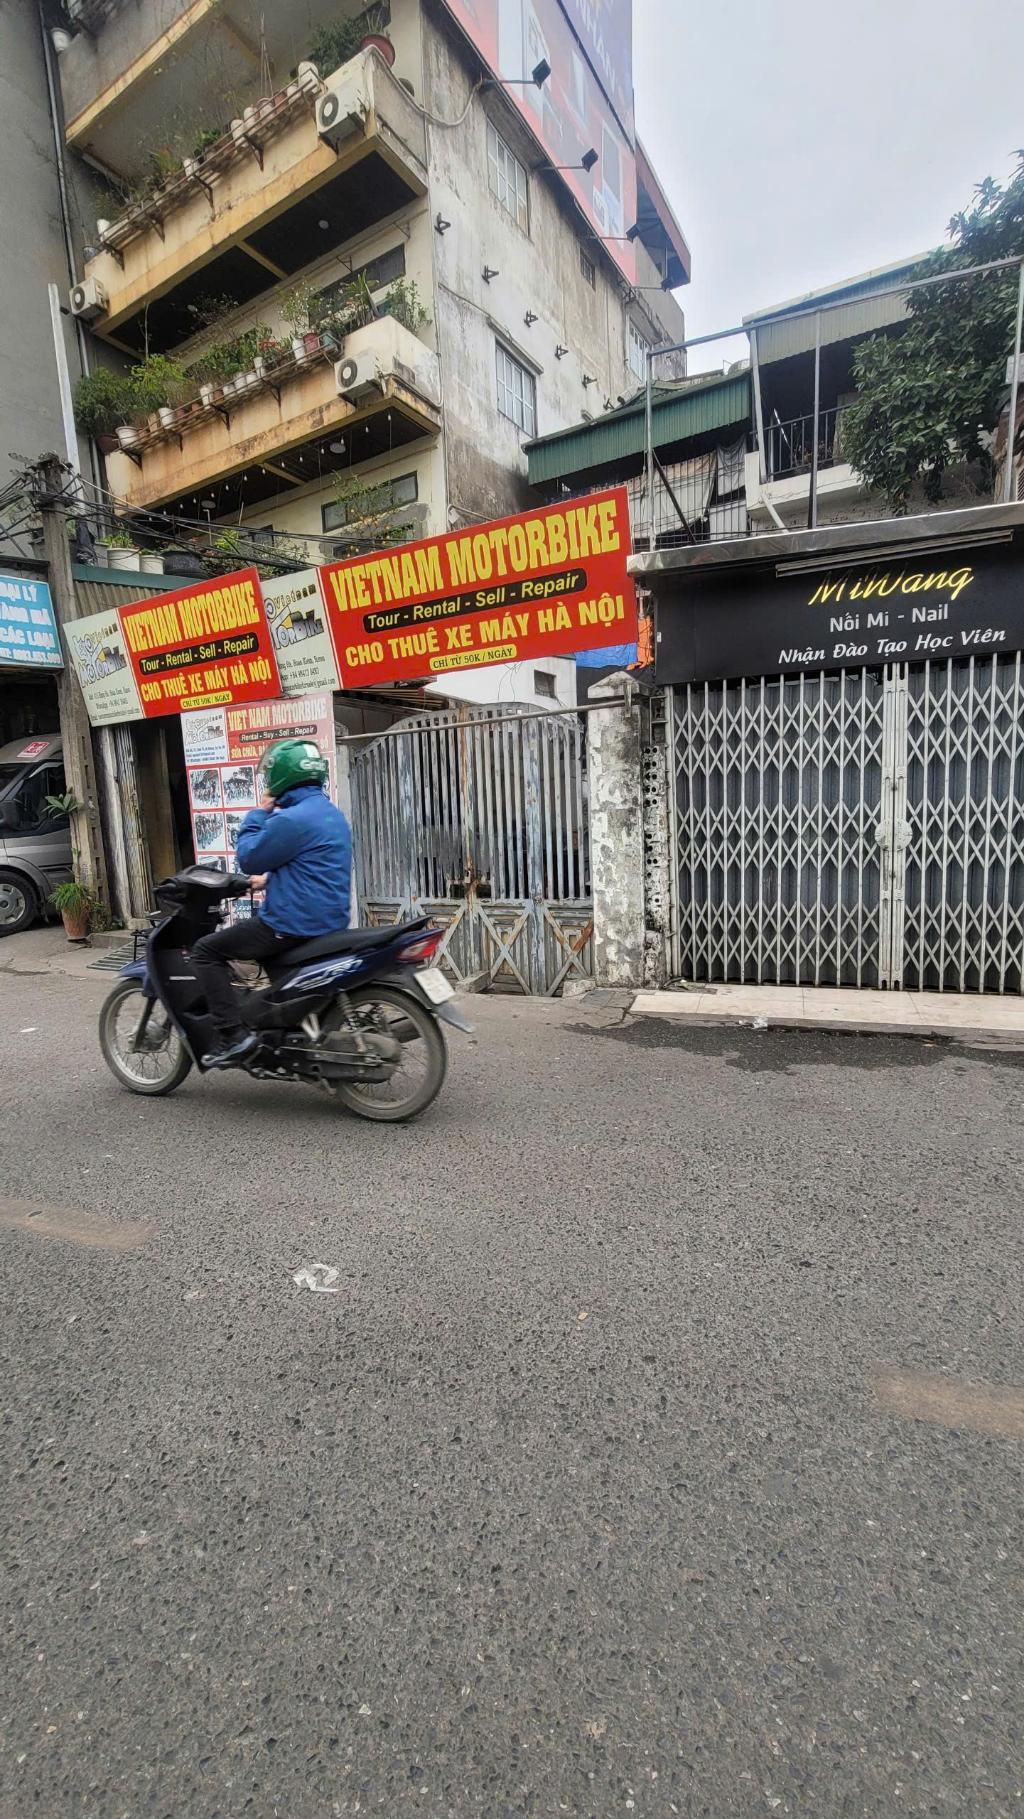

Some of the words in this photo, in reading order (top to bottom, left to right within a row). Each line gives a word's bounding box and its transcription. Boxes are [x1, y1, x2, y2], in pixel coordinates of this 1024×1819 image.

[329, 545, 444, 612] VIETNAM
[446, 499, 620, 587] MOTORBIKE
[123, 603, 184, 653] VIETNAM
[177, 581, 260, 640] MOTORBIKE
[368, 613, 400, 629] Tour
[413, 597, 461, 621] Rental
[476, 588, 505, 607] Sell
[521, 573, 579, 597] Repair
[829, 613, 860, 633] Nối
[867, 611, 889, 628] Mi
[912, 603, 948, 623] Nail
[345, 641, 384, 667] CHO
[388, 627, 440, 659] THUÊ
[444, 624, 474, 650] XE
[479, 612, 530, 643] MÁY
[537, 602, 572, 633] HÀ
[578, 592, 625, 628] NỘI
[778, 646, 825, 665] Nhận
[833, 643, 868, 659] Đào
[877, 638, 907, 657] Tạo
[915, 633, 952, 652] Học
[961, 628, 1006, 646] Viên
[141, 658, 161, 672] Tour
[166, 649, 193, 667] Rental
[200, 644, 216, 660] Sell
[224, 636, 255, 655] Repair
[433, 656, 448, 669] CHỈ
[450, 654, 461, 666] TỪ
[464, 653, 481, 664] 50K
[487, 646, 513, 660] NGÀY
[140, 682, 162, 702] CHO
[161, 673, 189, 698] THUÊ
[188, 674, 205, 694] XE
[204, 665, 228, 691] MÁY
[231, 659, 249, 686] HÀ
[249, 656, 272, 685] NỘI
[248, 706, 270, 728] NAM
[271, 698, 327, 725] MOTORBIKE
[241, 732, 259, 742] Rental
[294, 726, 315, 736] Repair
